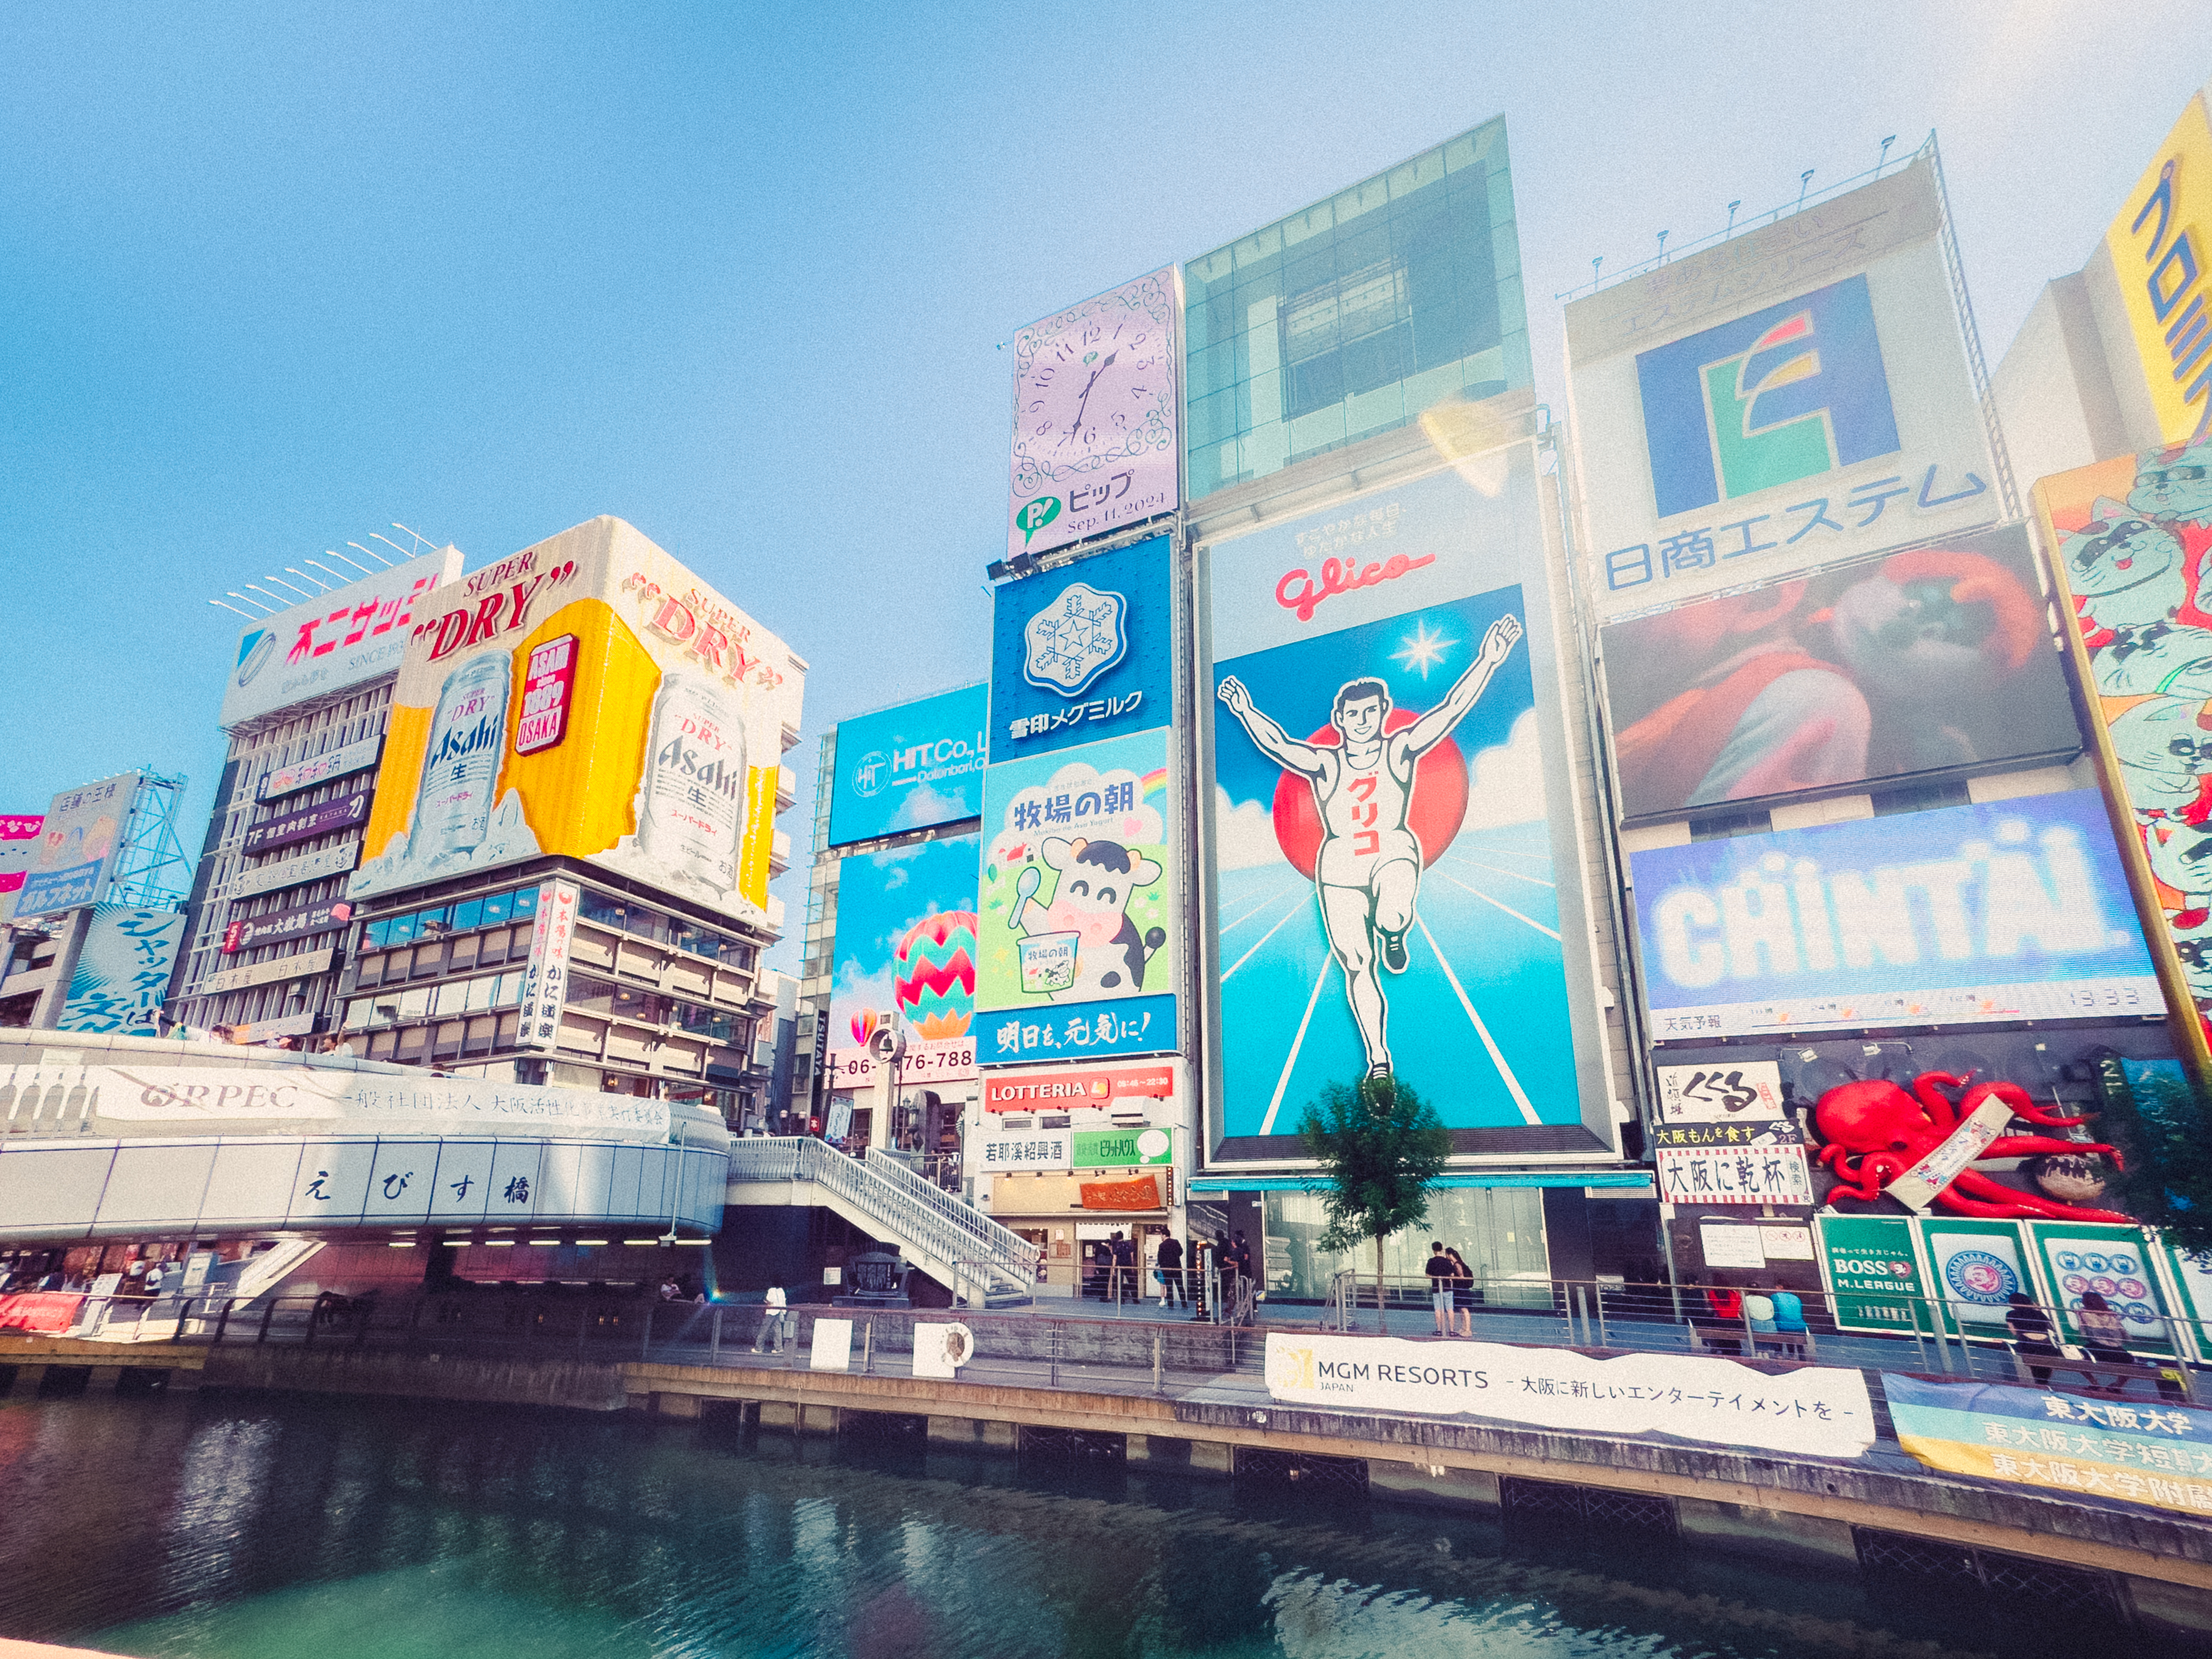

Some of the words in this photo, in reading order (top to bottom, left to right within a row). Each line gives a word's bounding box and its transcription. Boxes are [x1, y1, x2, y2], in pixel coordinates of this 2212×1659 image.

[1069, 469, 1135, 513] ピップ
[1068, 518, 1100, 535] Sep.
[1124, 493, 1168, 515] 2024
[1605, 464, 1987, 592] 日商エステム
[463, 551, 534, 598] SUPER
[690, 588, 751, 643] SUPER
[528, 642, 571, 682] ASAHI
[523, 679, 566, 717] 1889
[1009, 691, 1142, 739] 雪印メグミルク
[430, 712, 500, 770] Asahi
[518, 712, 559, 748] OSAKA
[450, 763, 467, 781] 生
[659, 734, 738, 802] Asahi
[687, 785, 707, 807] 生
[1014, 781, 1134, 832] 牧場の朝
[1347, 770, 1380, 857] グリコ
[248, 828, 263, 847] 7F
[227, 926, 238, 950] 5F
[552, 908, 569, 959] 本場の味
[278, 958, 317, 978] 白木屋
[1028, 946, 1068, 961] 牧場の朝
[520, 964, 540, 1037] かに道楽
[537, 964, 561, 1039] かに道楽
[1664, 1014, 1722, 1032] 天気予報
[814, 1015, 827, 1076] TSUTAYA
[991, 1082, 1087, 1102] LOTTERIA
[811, 1119, 819, 1129] 本
[1657, 1125, 1756, 1145] 大阪もんを食す
[1778, 1134, 1798, 1144] 2F
[1100, 1139, 1136, 1158] ピタットハウス
[304, 1170, 530, 1204] えびす橋
[1667, 1156, 1785, 1194] 大阪に乾杯
[1789, 1161, 1803, 1186] 検索
[1833, 1258, 1889, 1276] BOSS
[1837, 1278, 1915, 1292] M.LEAGUE
[1318, 1360, 1370, 1381] MGM
[1377, 1364, 1488, 1389] RESORTS
[1320, 1381, 1354, 1393] JAPAN
[2041, 1395, 2194, 1435] 東大阪大学
[1990, 1452, 2212, 1510] 東大阪大学附属
